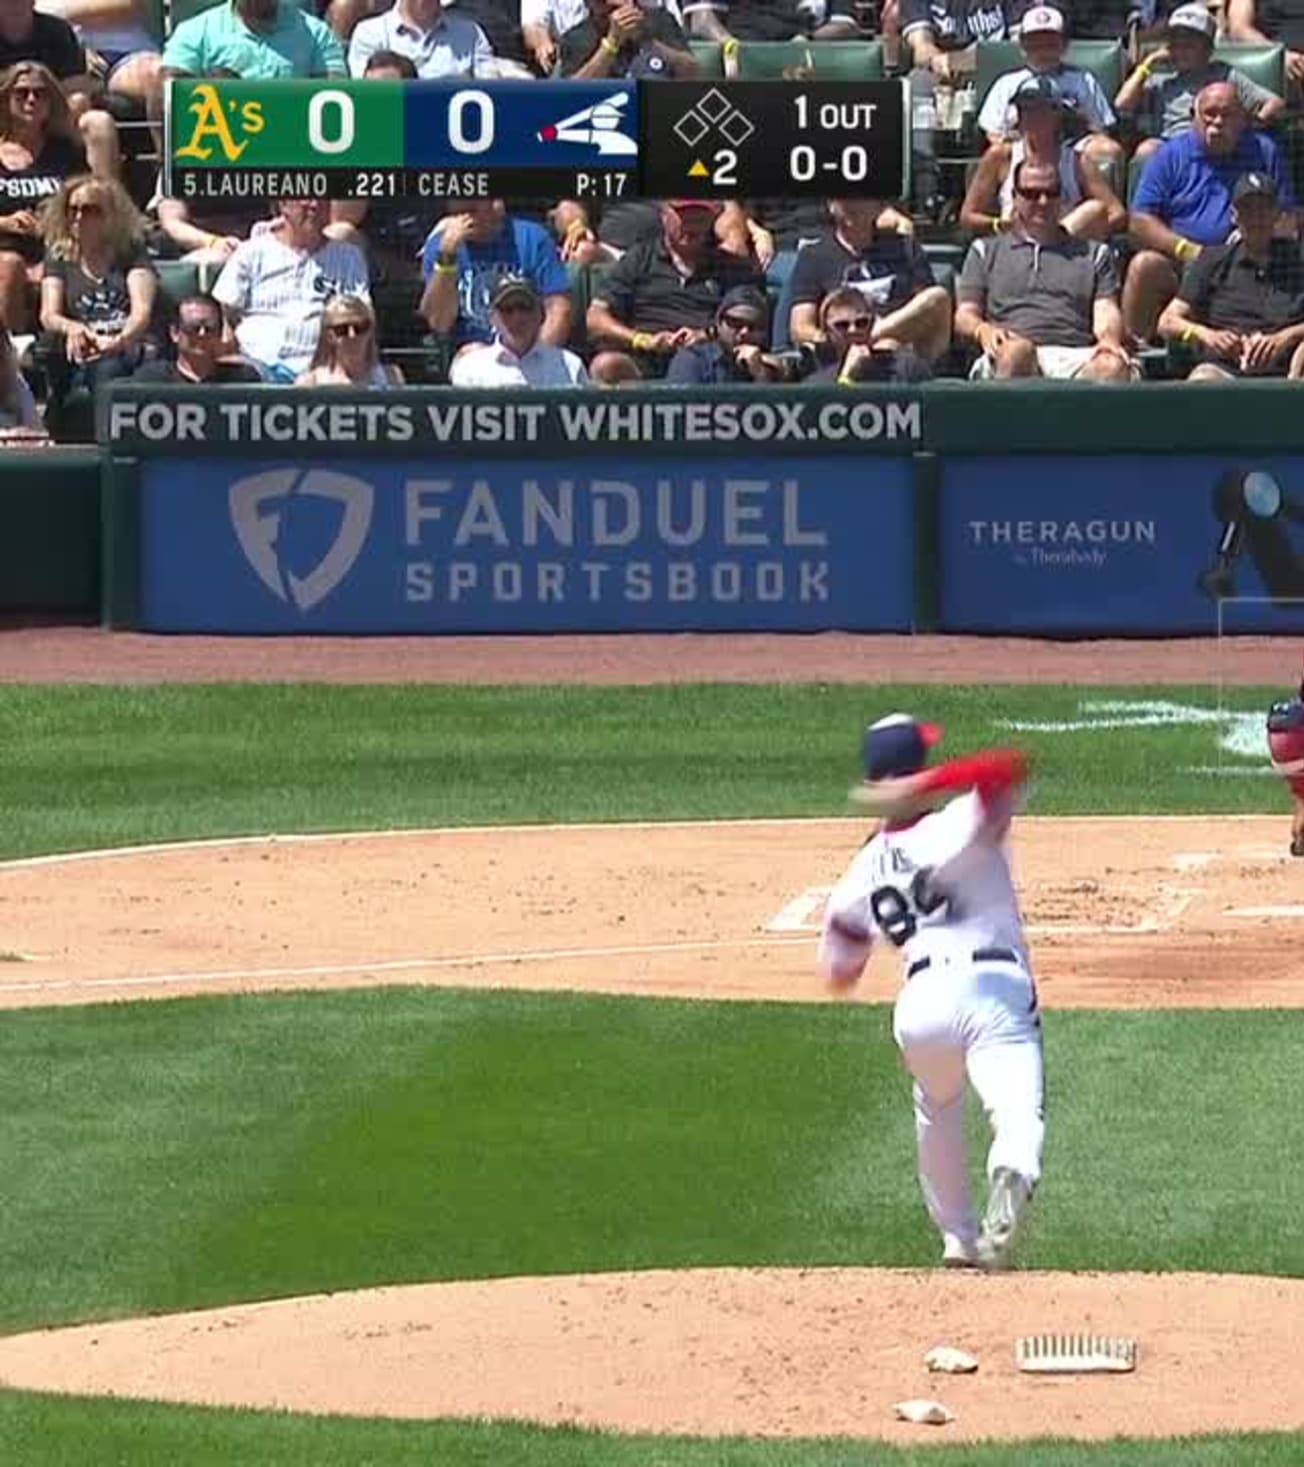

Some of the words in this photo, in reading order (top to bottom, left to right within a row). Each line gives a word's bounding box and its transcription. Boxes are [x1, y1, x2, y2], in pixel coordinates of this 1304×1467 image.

[110, 403, 205, 440] FOR
[221, 405, 413, 441] TICKETS
[429, 406, 545, 441] VISIT
[560, 404, 921, 441] WHITESOX.COM
[405, 480, 828, 546] FANDUEL
[969, 520, 1156, 543] THERAGUN
[406, 562, 829, 602] SPORTSBOOK
